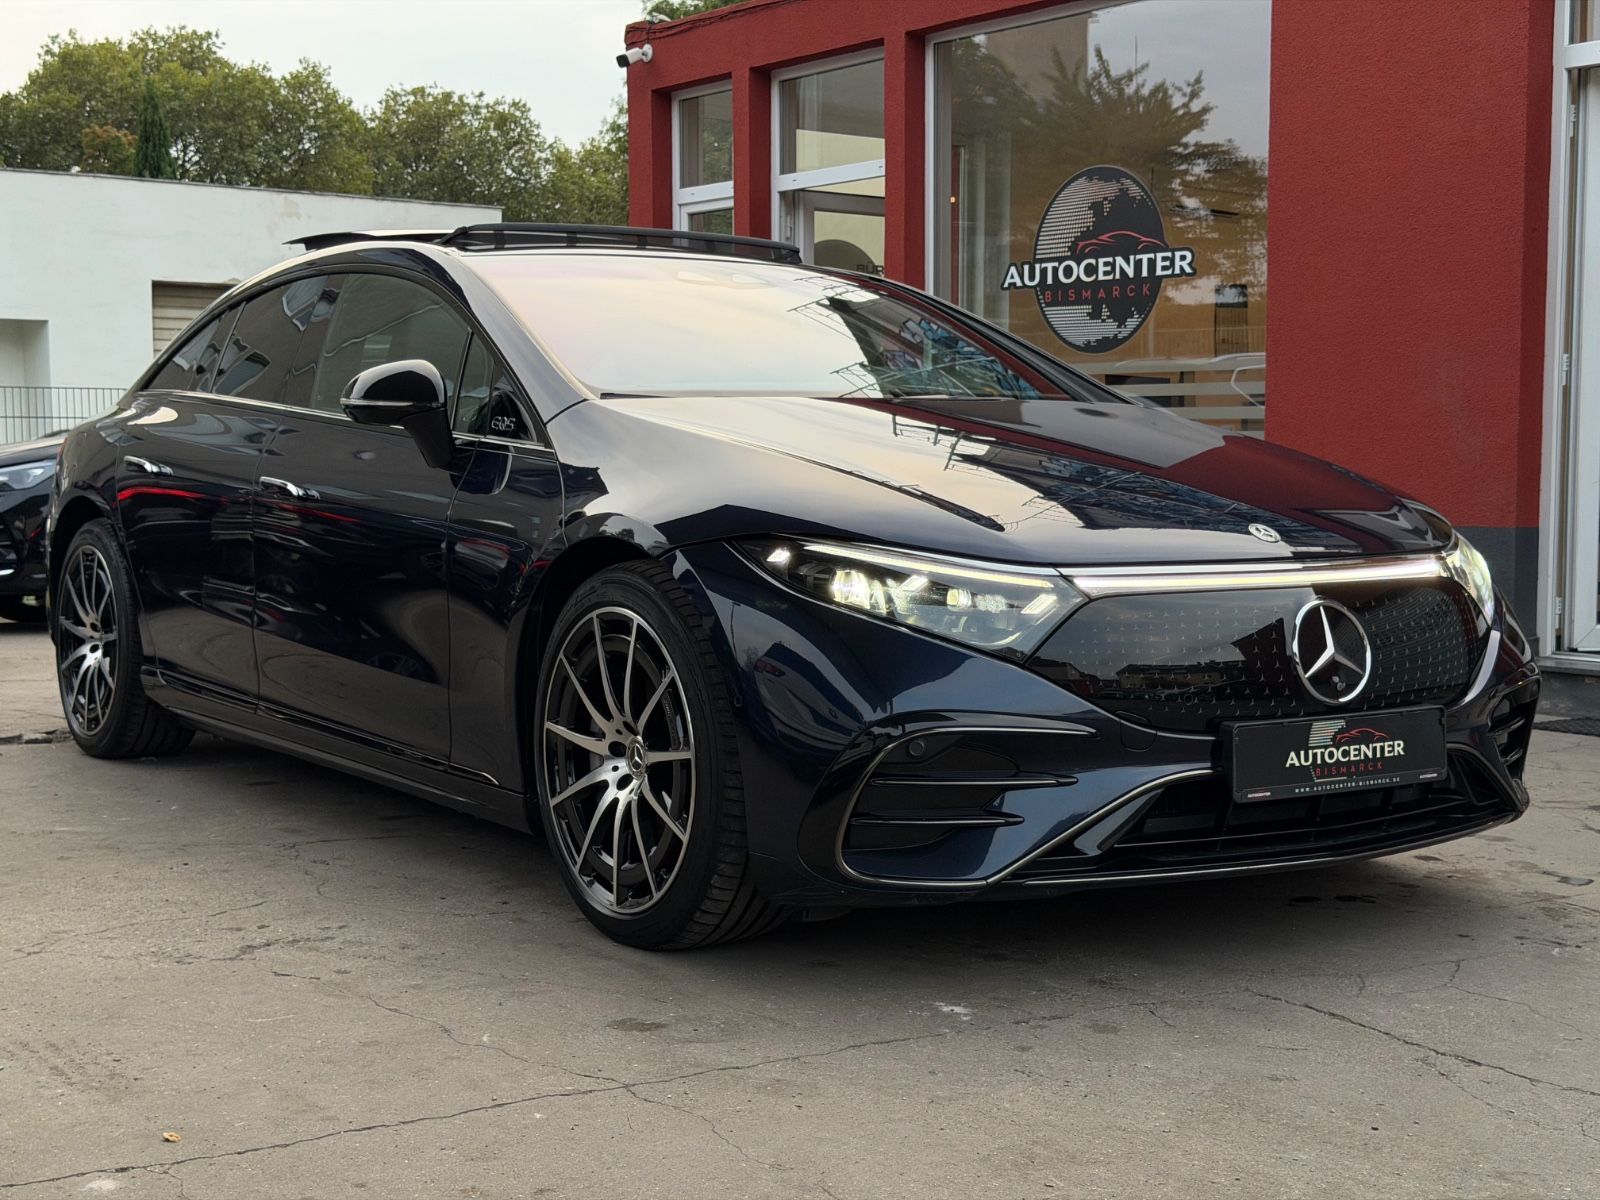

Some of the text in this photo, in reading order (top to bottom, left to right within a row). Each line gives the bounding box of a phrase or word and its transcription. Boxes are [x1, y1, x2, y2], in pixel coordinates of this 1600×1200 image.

[1003, 250, 1194, 288] AUTOCENTER
[1044, 283, 1151, 303] BISMARCK
[491, 416, 516, 431] EQS
[1285, 740, 1405, 768] AUTOCENTER
[1315, 761, 1383, 777] BISMARCK
